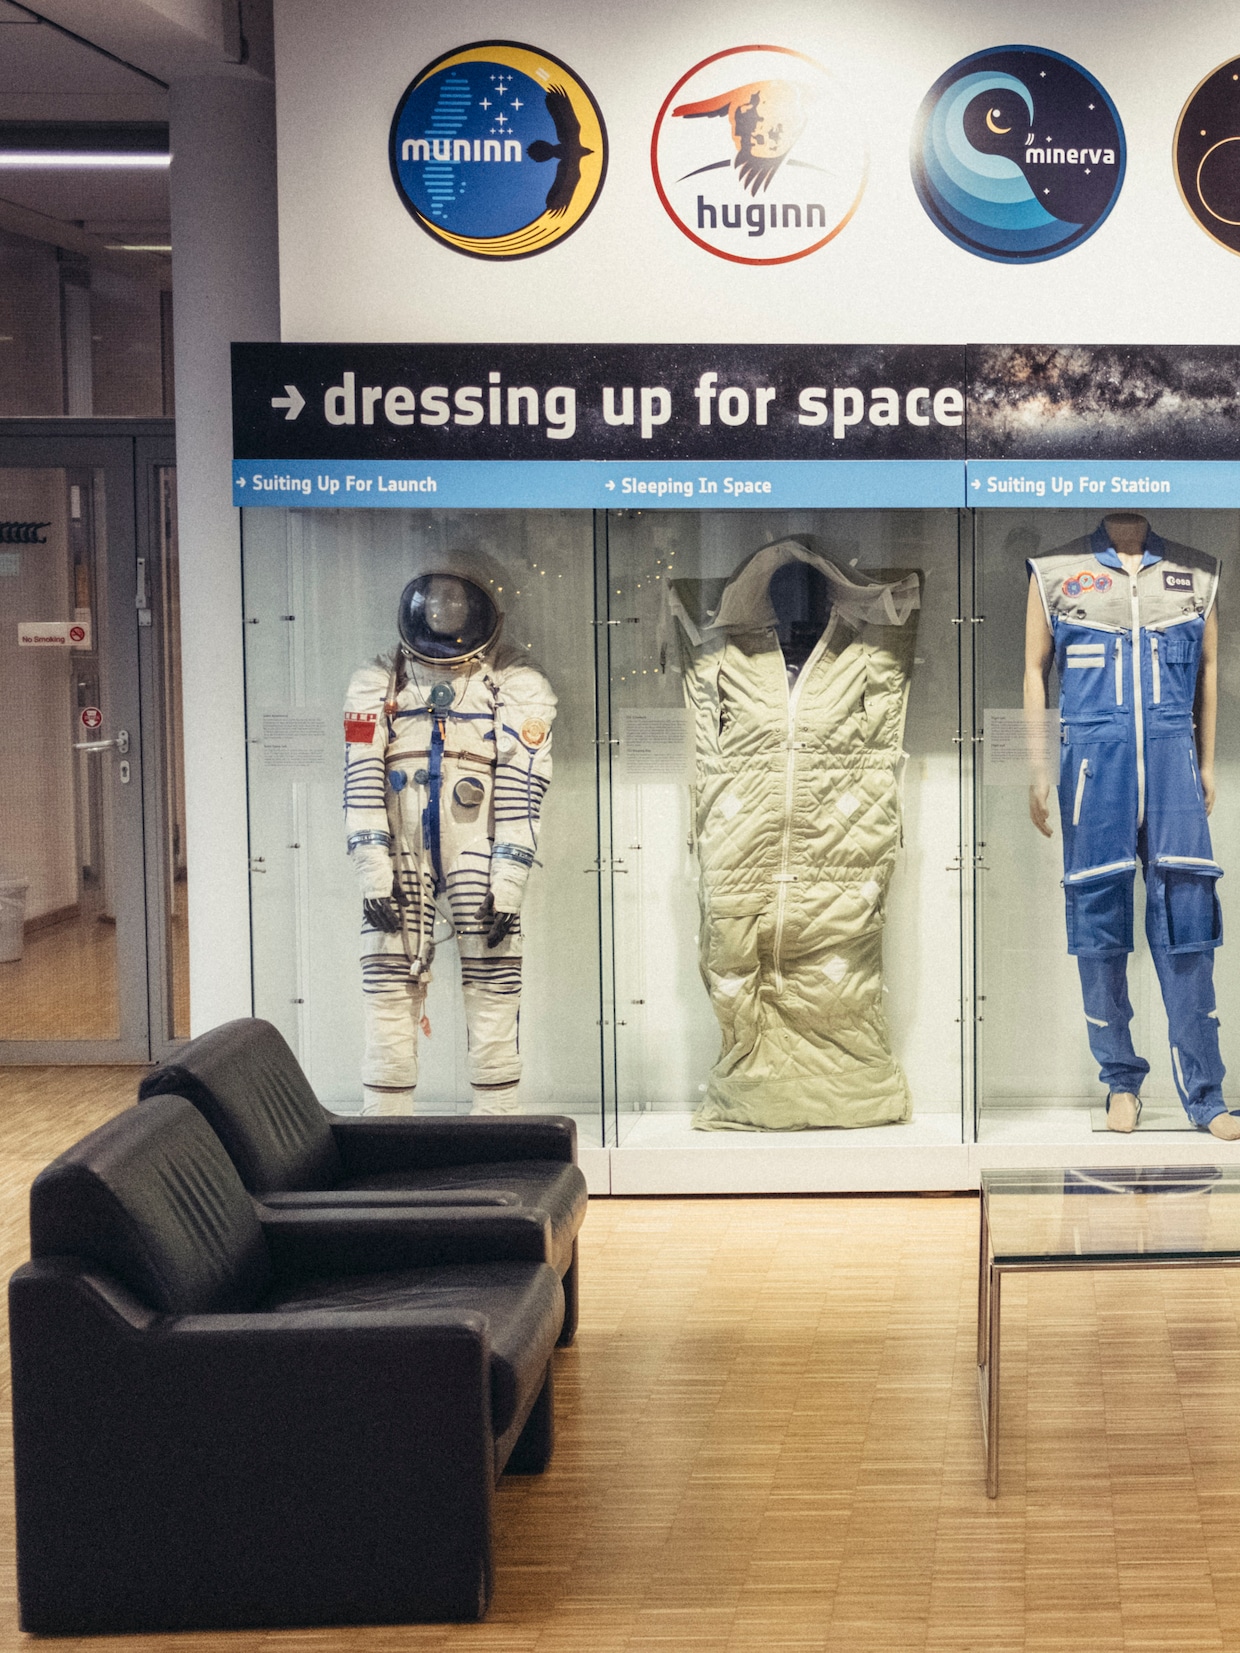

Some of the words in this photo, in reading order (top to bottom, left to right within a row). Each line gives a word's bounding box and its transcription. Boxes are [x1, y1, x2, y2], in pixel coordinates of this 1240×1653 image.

[402, 139, 522, 162] muninn
[1025, 145, 1115, 165] minerva
[697, 195, 826, 237] huginn
[323, 372, 576, 440] dressing
[603, 387, 671, 439] up
[695, 372, 776, 426] for
[798, 387, 965, 439] space
[252, 476, 311, 495] Suiting
[317, 476, 340, 495] Up
[346, 476, 373, 491] For
[378, 476, 437, 492] Launch
[621, 477, 694, 498] Sleeping
[698, 477, 718, 494] In
[723, 477, 772, 498] Space
[987, 476, 1046, 497] Suiting
[1051, 476, 1074, 497] Up
[1079, 476, 1106, 493] For
[1111, 476, 1171, 493] Station
[22, 635, 32, 643] No
[34, 635, 65, 645] Smoking
